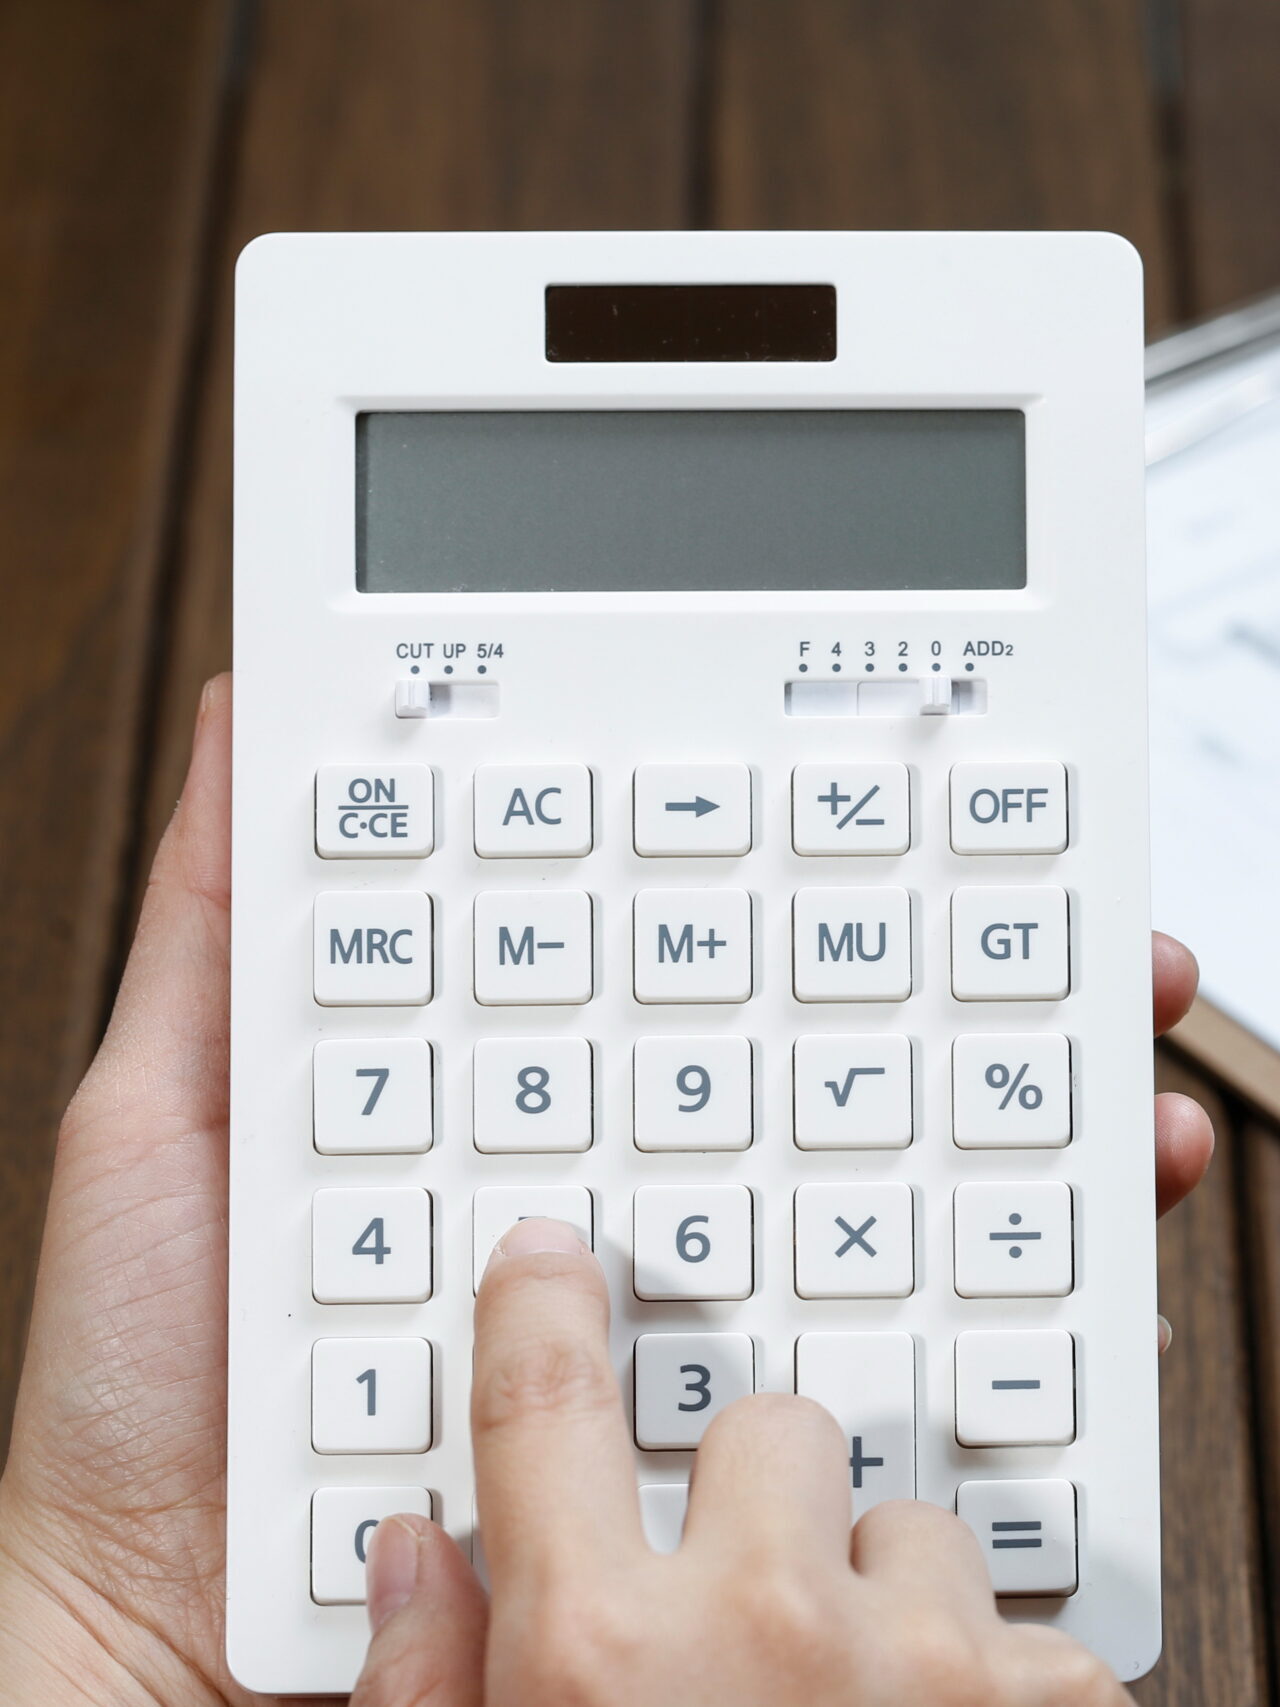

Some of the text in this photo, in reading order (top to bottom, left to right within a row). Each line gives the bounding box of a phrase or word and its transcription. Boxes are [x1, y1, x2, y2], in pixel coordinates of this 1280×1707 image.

[395, 642, 504, 660] CUT UP 5/4
[799, 641, 811, 657] F
[830, 641, 842, 657] 4
[864, 640, 876, 657] 3
[897, 640, 909, 657] 2
[930, 640, 942, 657] 0
[348, 777, 396, 804] ON
[501, 786, 562, 826] AC
[969, 787, 1049, 824] OFF
[329, 928, 413, 965] MRC
[658, 923, 727, 964] M+
[818, 922, 887, 963] MU
[980, 922, 1039, 961] GT
[355, 1067, 390, 1116] 7
[515, 1065, 552, 1115] 8
[675, 1064, 712, 1113] 9
[984, 1062, 1043, 1111] %
[351, 1217, 392, 1265] 4
[675, 1214, 711, 1264] 6
[355, 1368, 377, 1417] 1
[677, 1363, 712, 1413] 3
